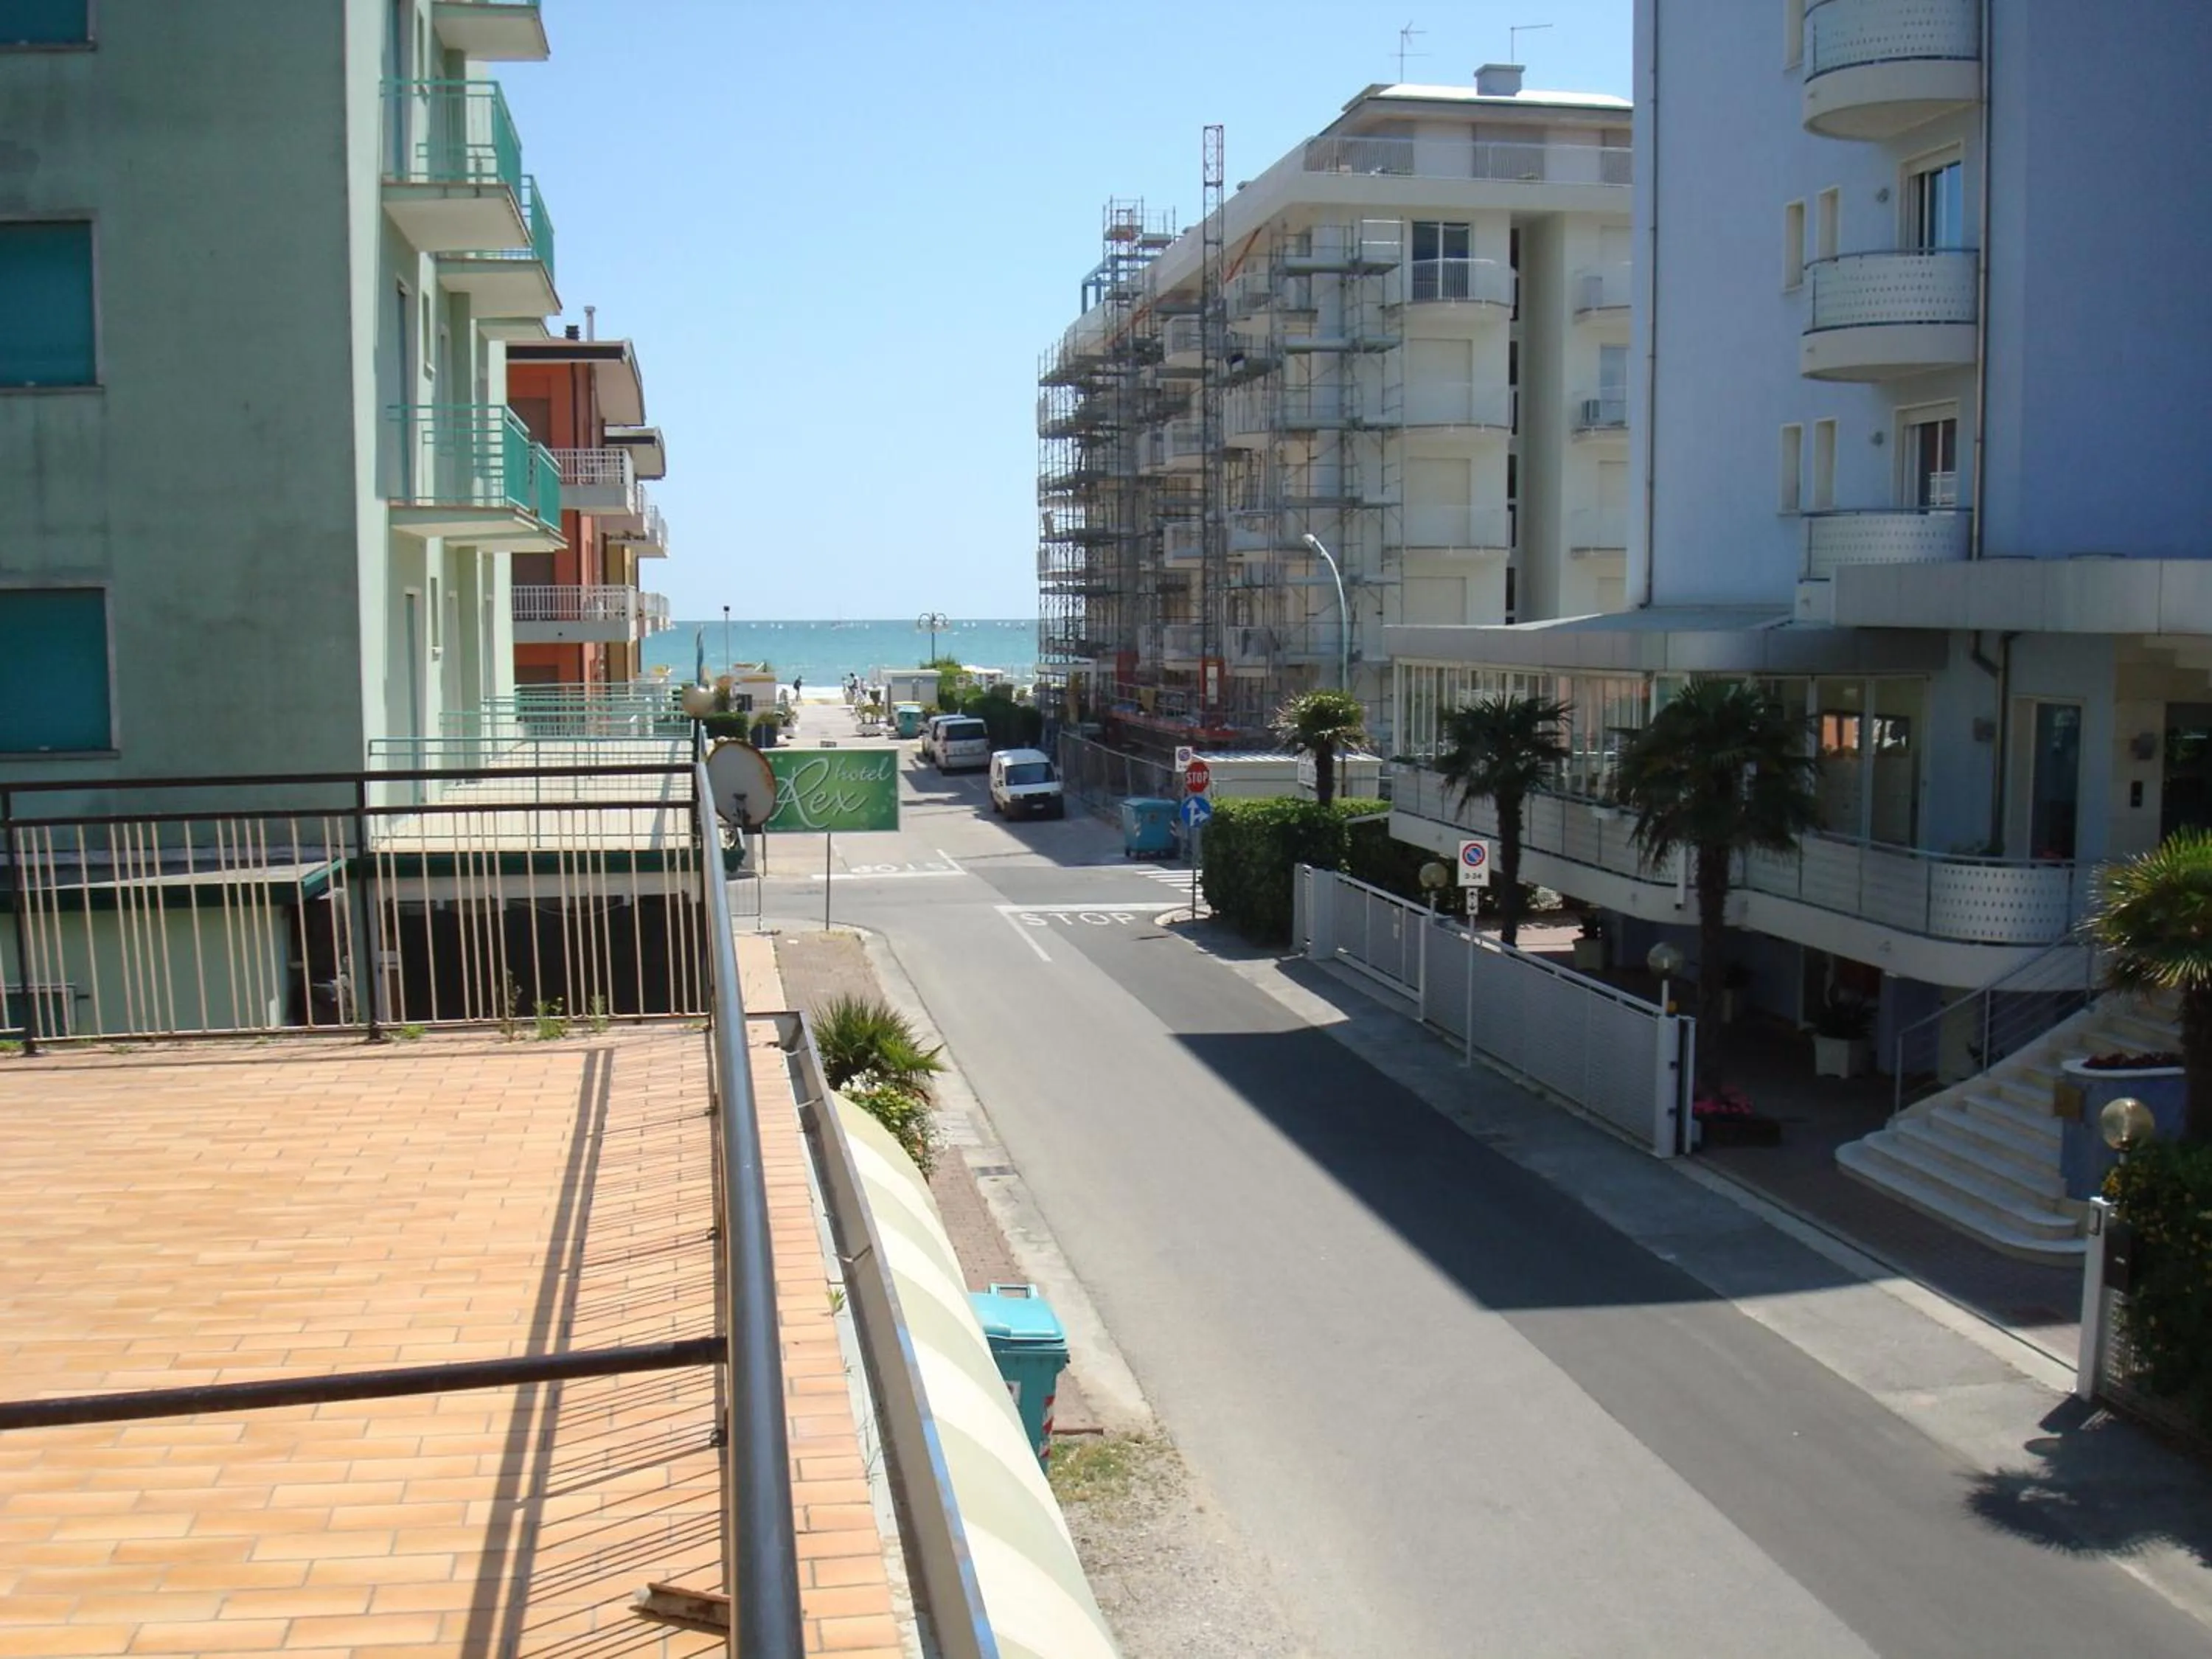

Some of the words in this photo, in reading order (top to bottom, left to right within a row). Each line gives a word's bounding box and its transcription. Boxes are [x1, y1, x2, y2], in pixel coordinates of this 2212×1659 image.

[834, 756, 891, 782] hotel
[1186, 771, 1208, 785] STOP
[768, 757, 870, 829] Rex
[1020, 911, 1137, 926] STOP
